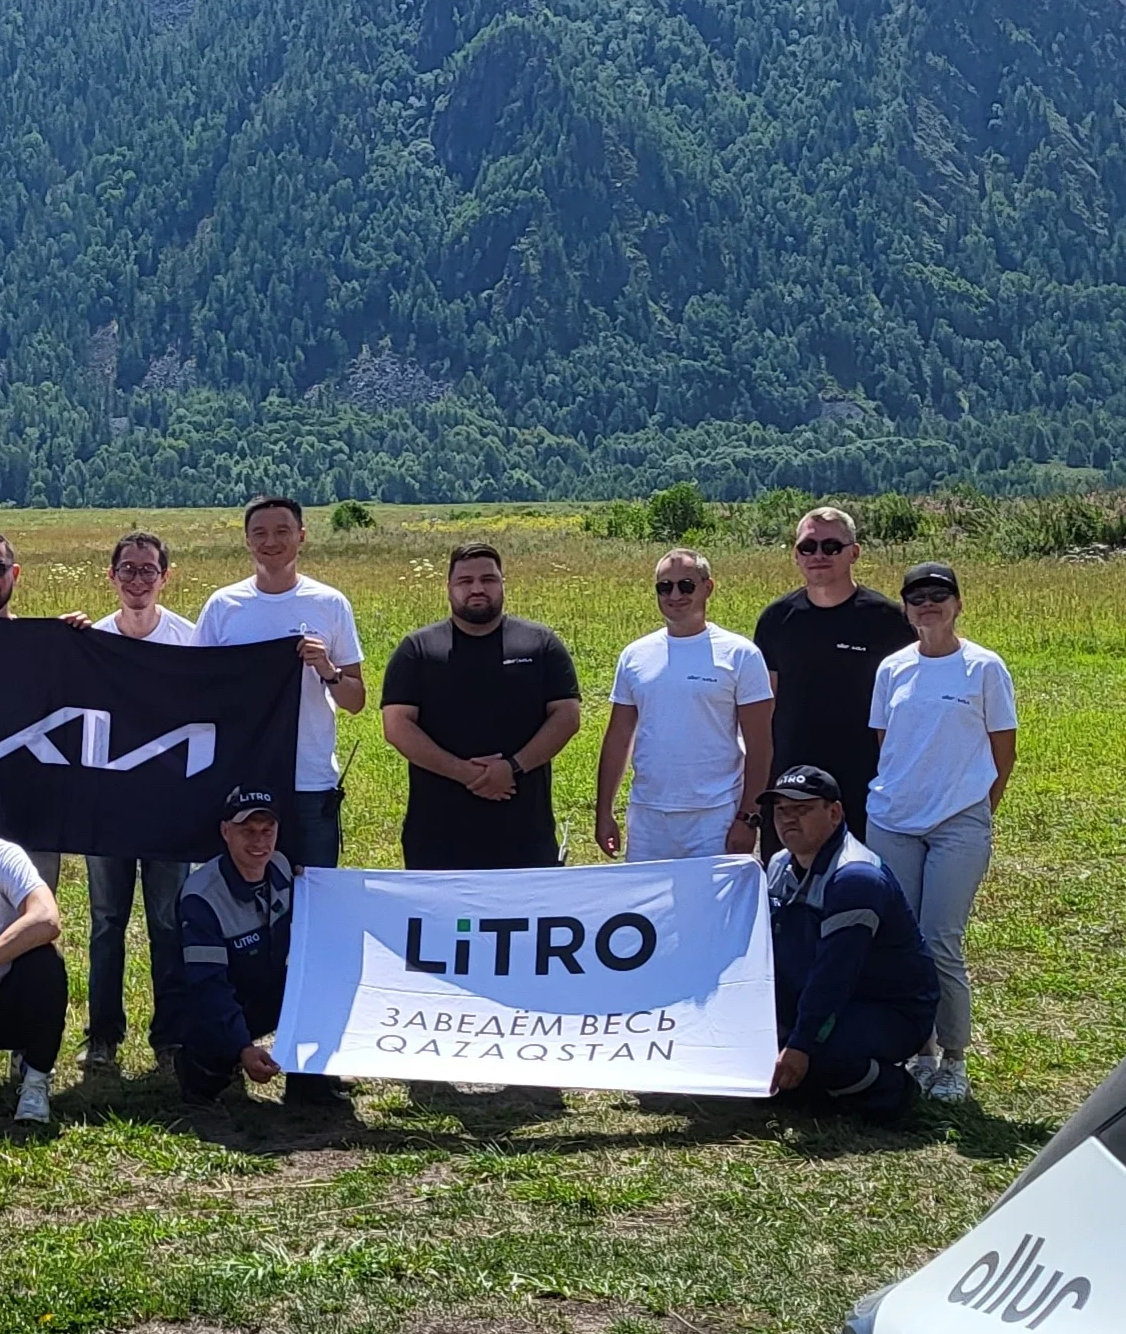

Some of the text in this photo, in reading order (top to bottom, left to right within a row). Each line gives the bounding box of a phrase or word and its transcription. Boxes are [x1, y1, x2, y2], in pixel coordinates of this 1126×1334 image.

[380, 1007, 676, 1038] ЗАВЕДЁМ ВЕСЬ
[376, 1035, 674, 1062] QAZAQSTAN
[948, 1233, 1092, 1331] allur
